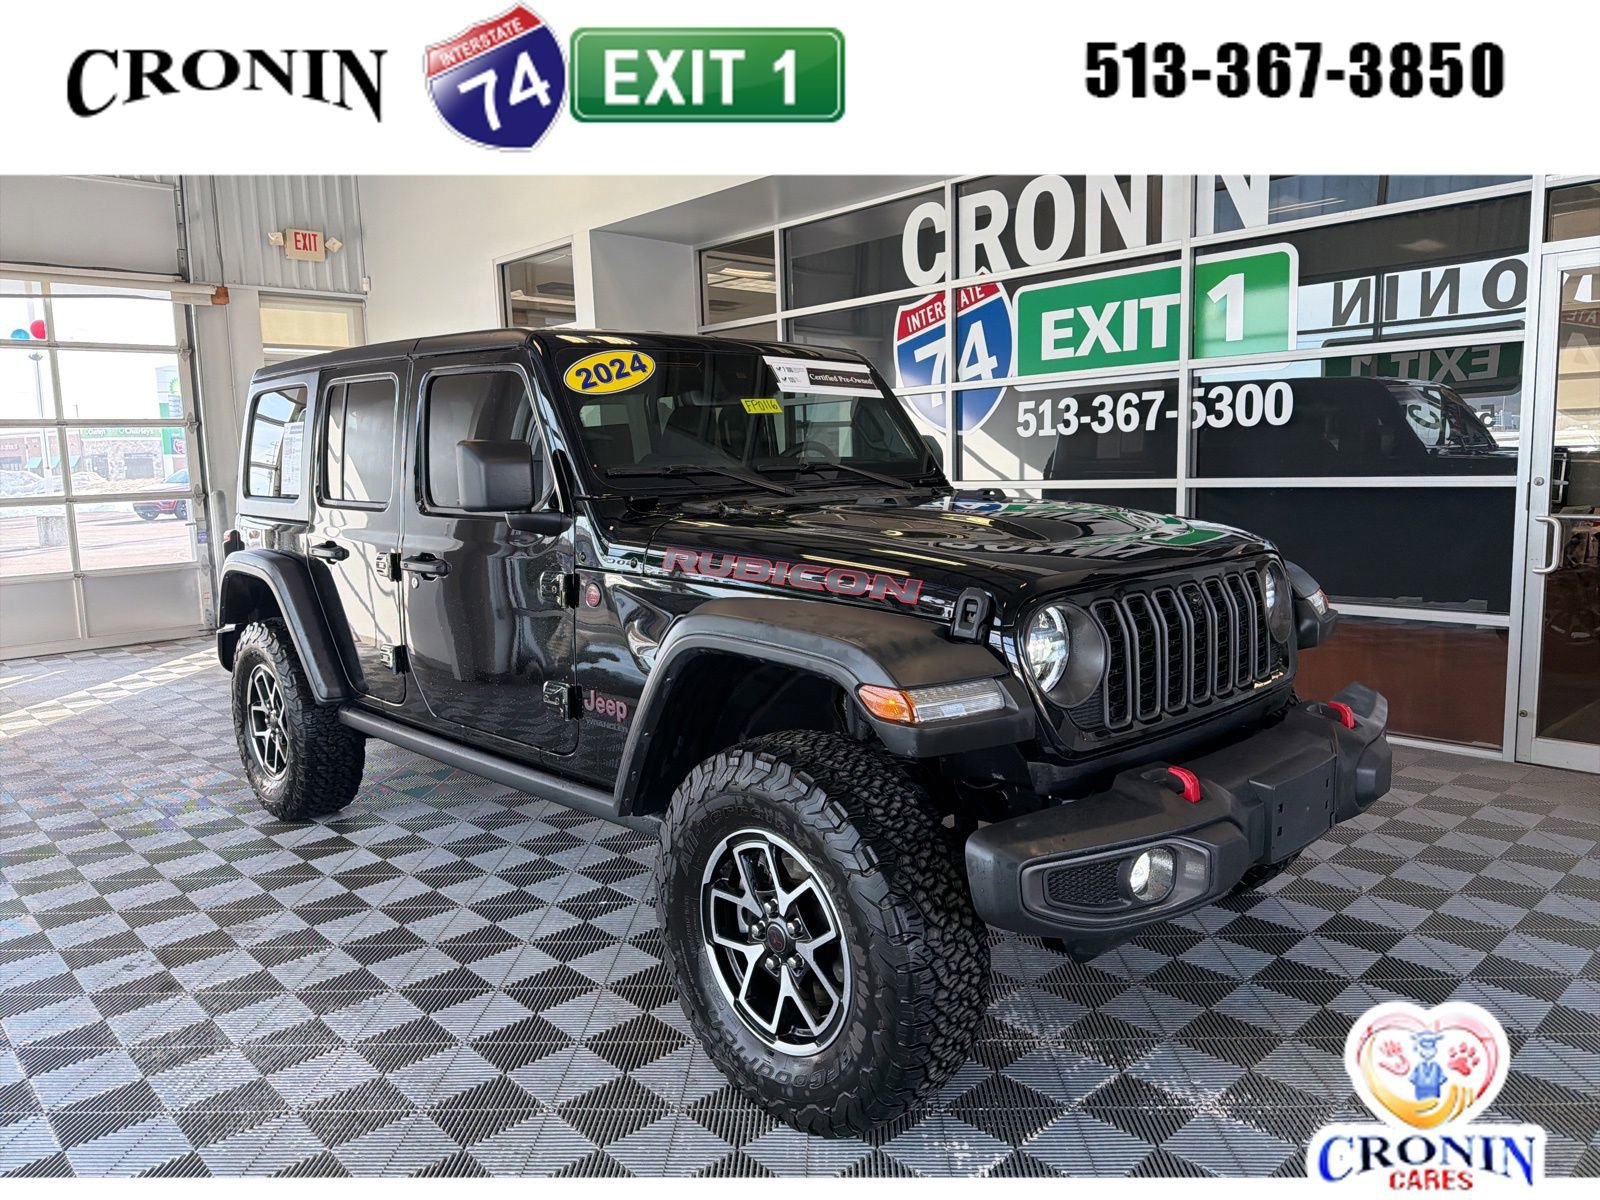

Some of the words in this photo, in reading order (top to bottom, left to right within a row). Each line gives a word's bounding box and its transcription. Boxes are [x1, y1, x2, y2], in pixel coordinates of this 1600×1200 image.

[294, 231, 319, 252] EXIT
[902, 174, 1269, 287] CRONIN
[1041, 293, 1180, 361] EXIT
[1207, 272, 1245, 342] 1
[575, 353, 649, 390] 2024
[809, 373, 838, 382] Certified
[838, 375, 873, 385] Pre-Owned
[914, 320, 998, 408] 74
[1017, 381, 1294, 437] 513-367-5300
[662, 546, 923, 605] RUBICON
[584, 690, 628, 723] Jeep
